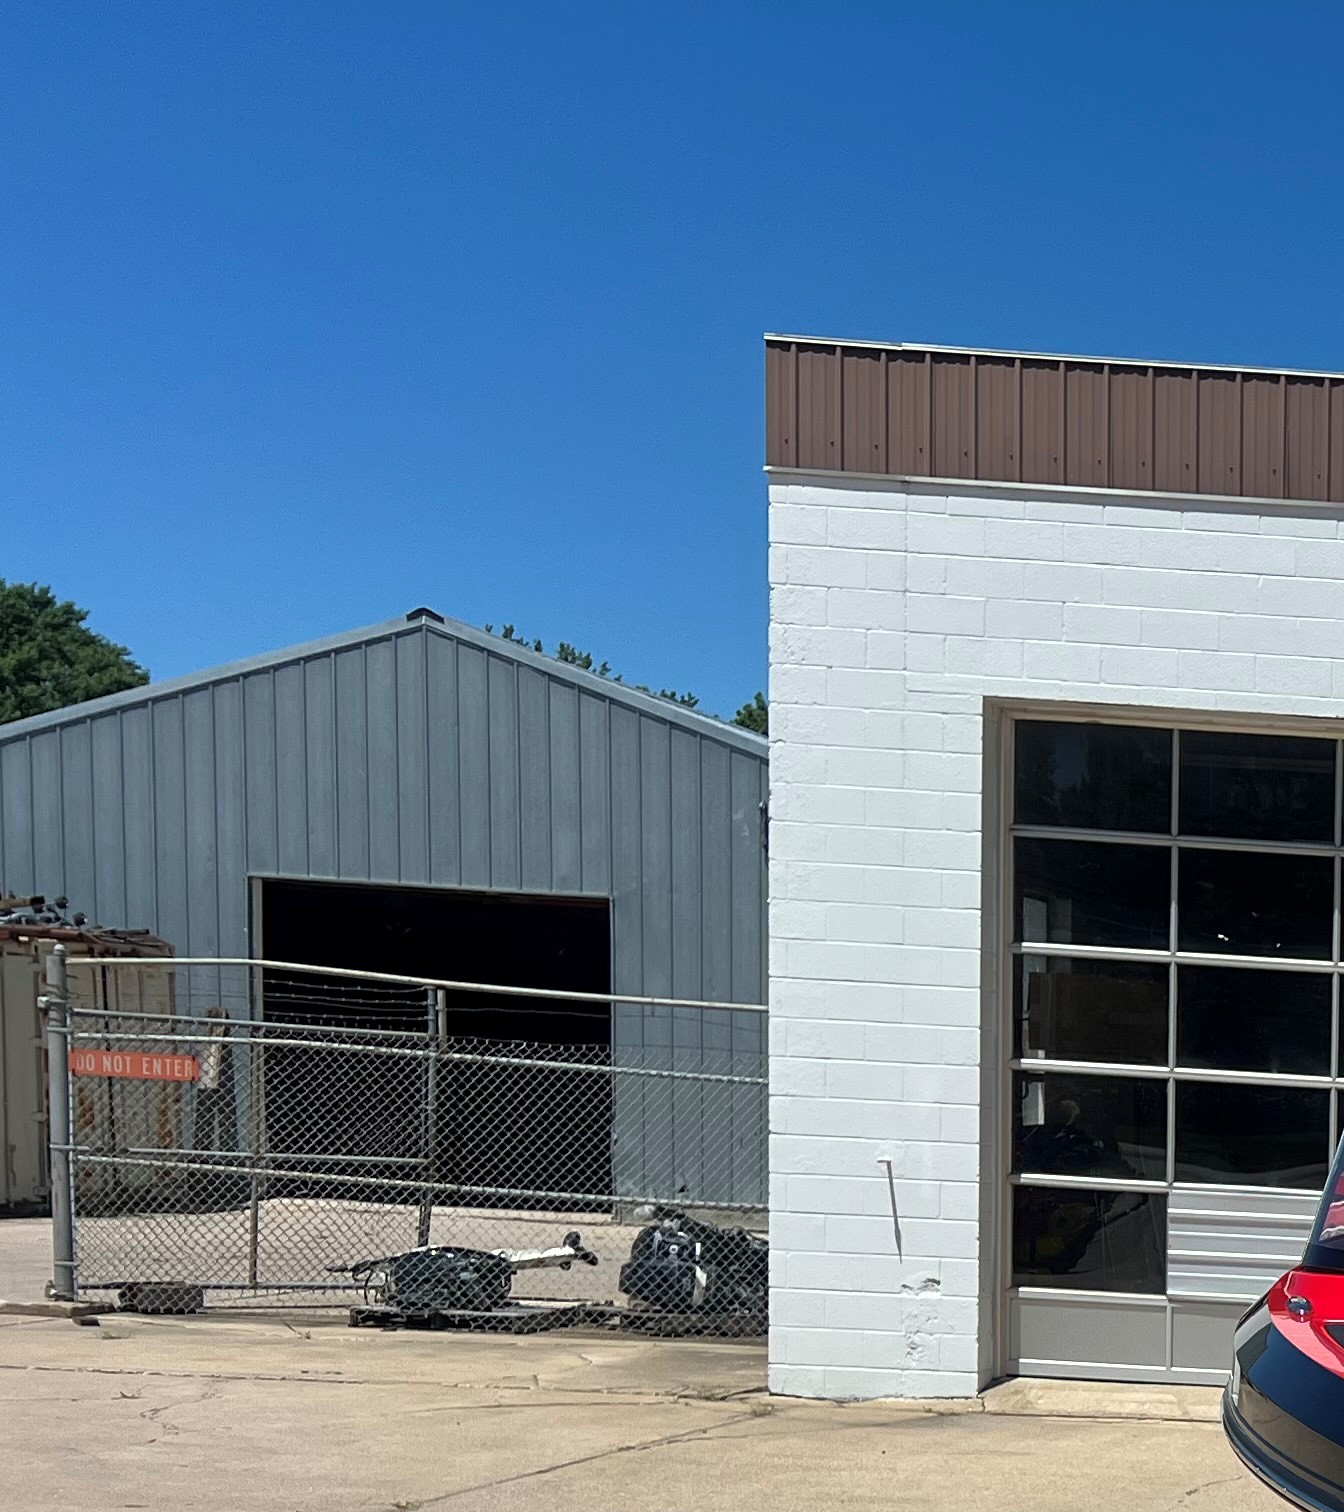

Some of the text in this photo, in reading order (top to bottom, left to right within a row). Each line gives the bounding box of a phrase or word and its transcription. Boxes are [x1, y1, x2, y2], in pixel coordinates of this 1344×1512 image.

[76, 1053, 194, 1078] DO NOT ENTER
